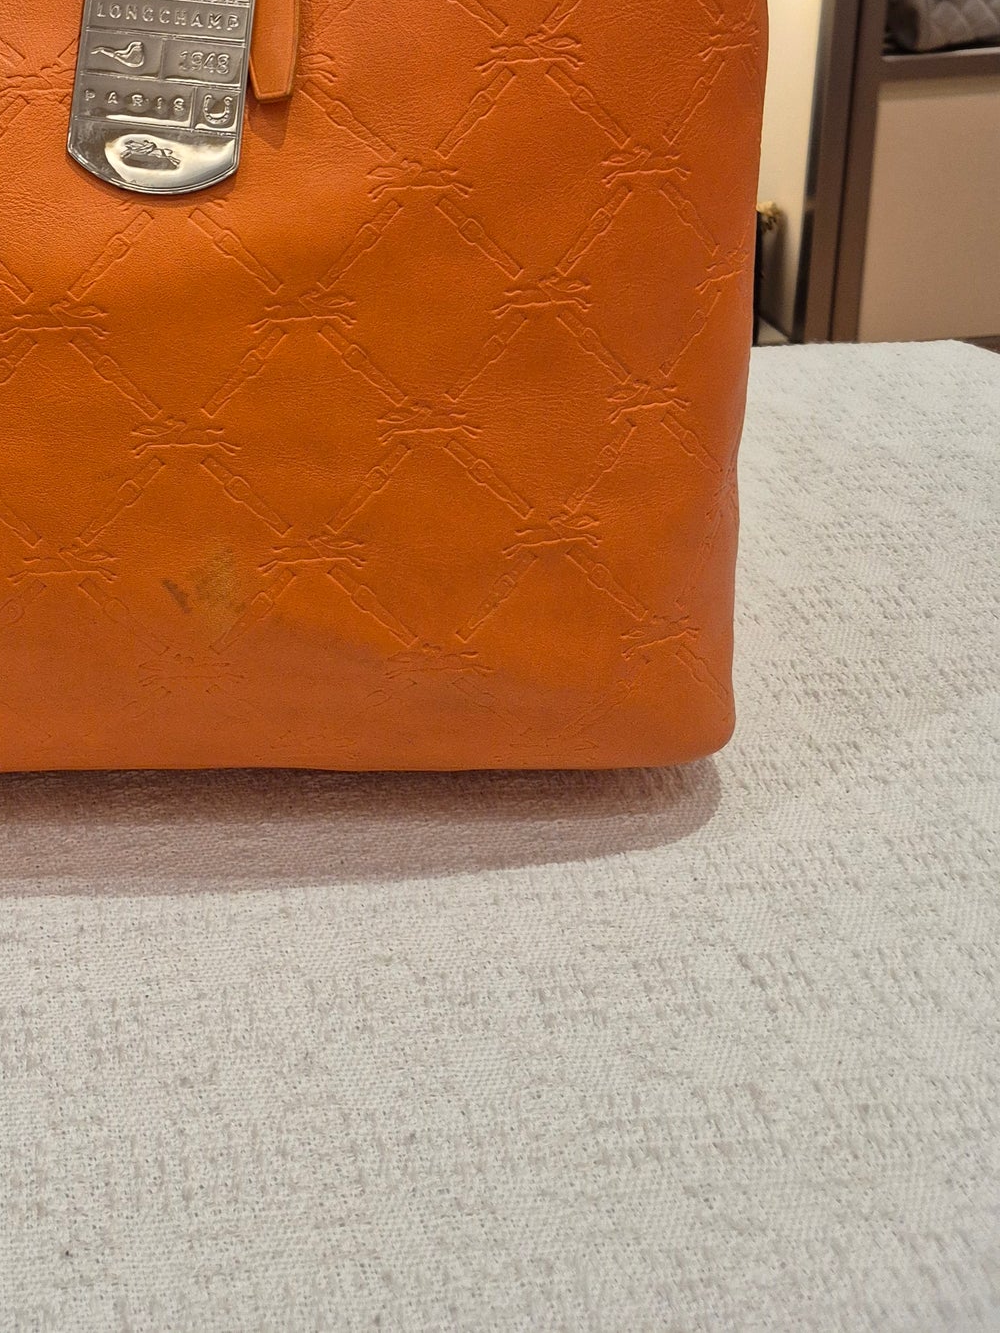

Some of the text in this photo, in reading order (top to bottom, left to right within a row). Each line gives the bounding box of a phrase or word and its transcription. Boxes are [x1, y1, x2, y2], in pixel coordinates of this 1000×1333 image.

[96, 1, 240, 31] LONGCHAMP
[178, 49, 231, 75] 1948
[83, 89, 185, 112] PARIS
